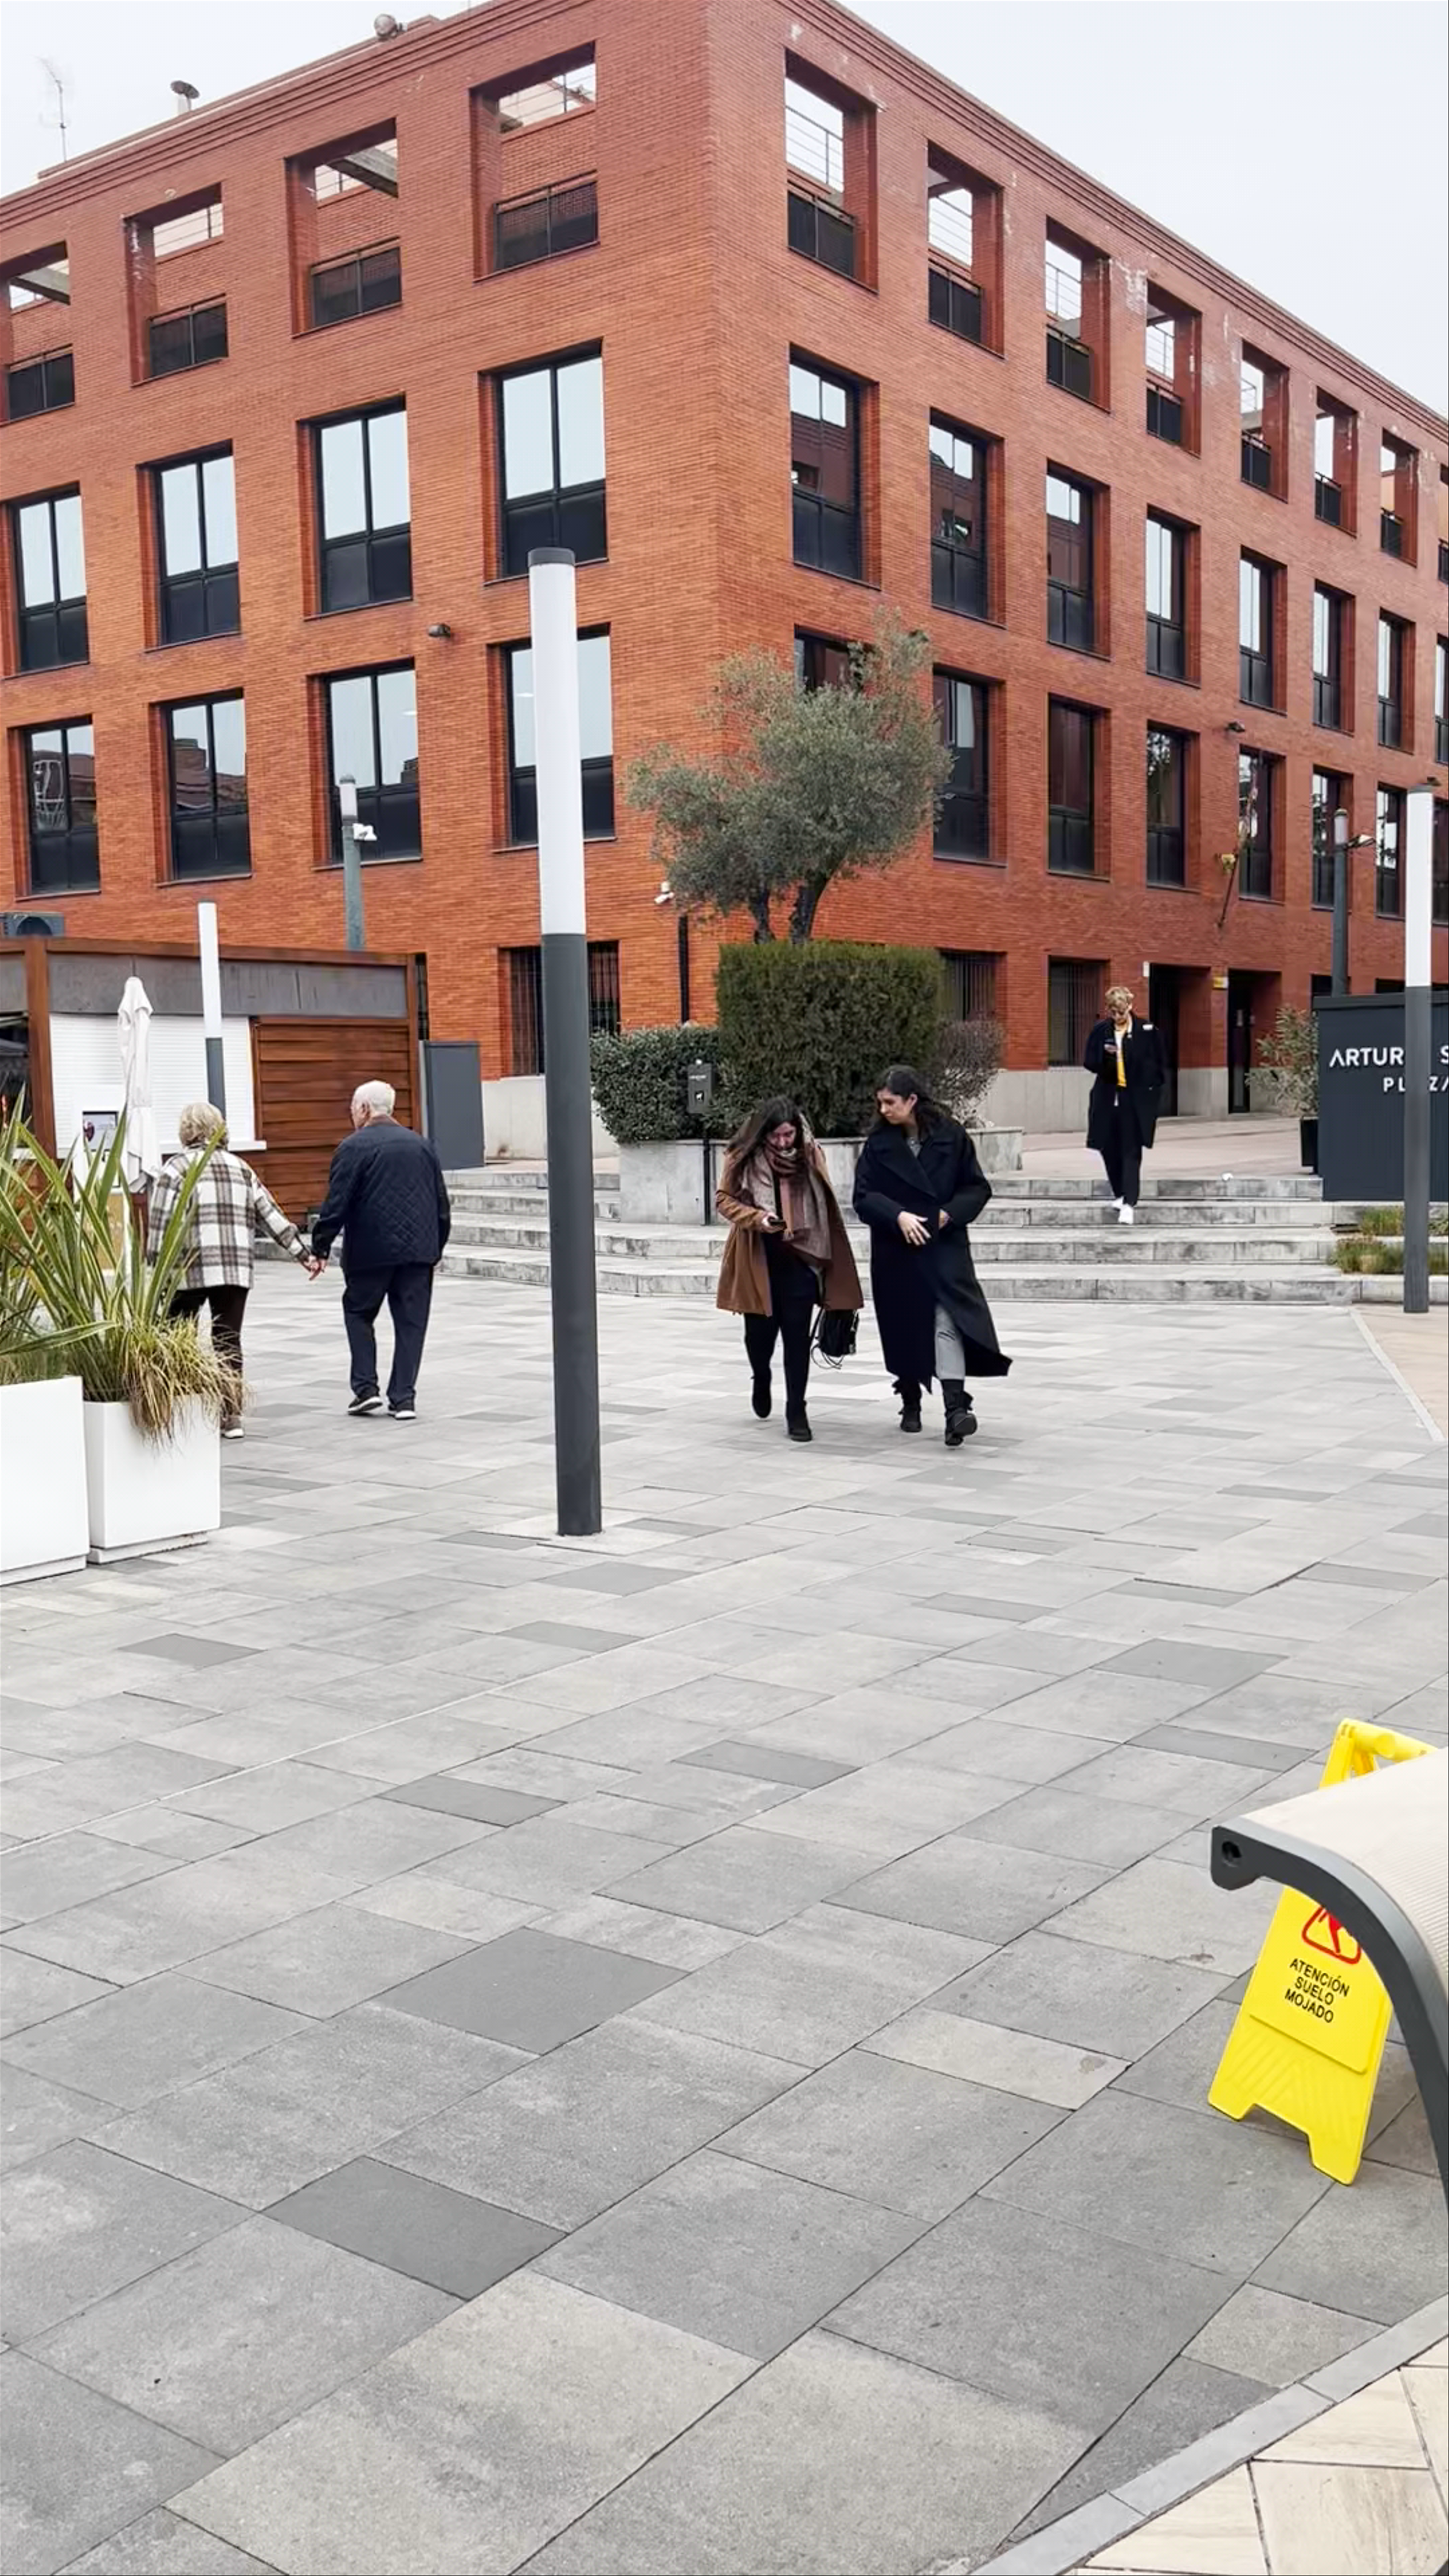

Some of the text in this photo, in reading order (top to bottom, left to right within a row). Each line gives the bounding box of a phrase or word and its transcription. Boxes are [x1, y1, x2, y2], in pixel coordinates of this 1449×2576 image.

[1329, 1046, 1404, 1067] ARTUR
[1383, 1076, 1449, 1092] PLZ
[1289, 1958, 1350, 1997] ATENCIÓN
[1295, 1976, 1334, 2005] SUELO
[1284, 1988, 1334, 2023] MOJADO
